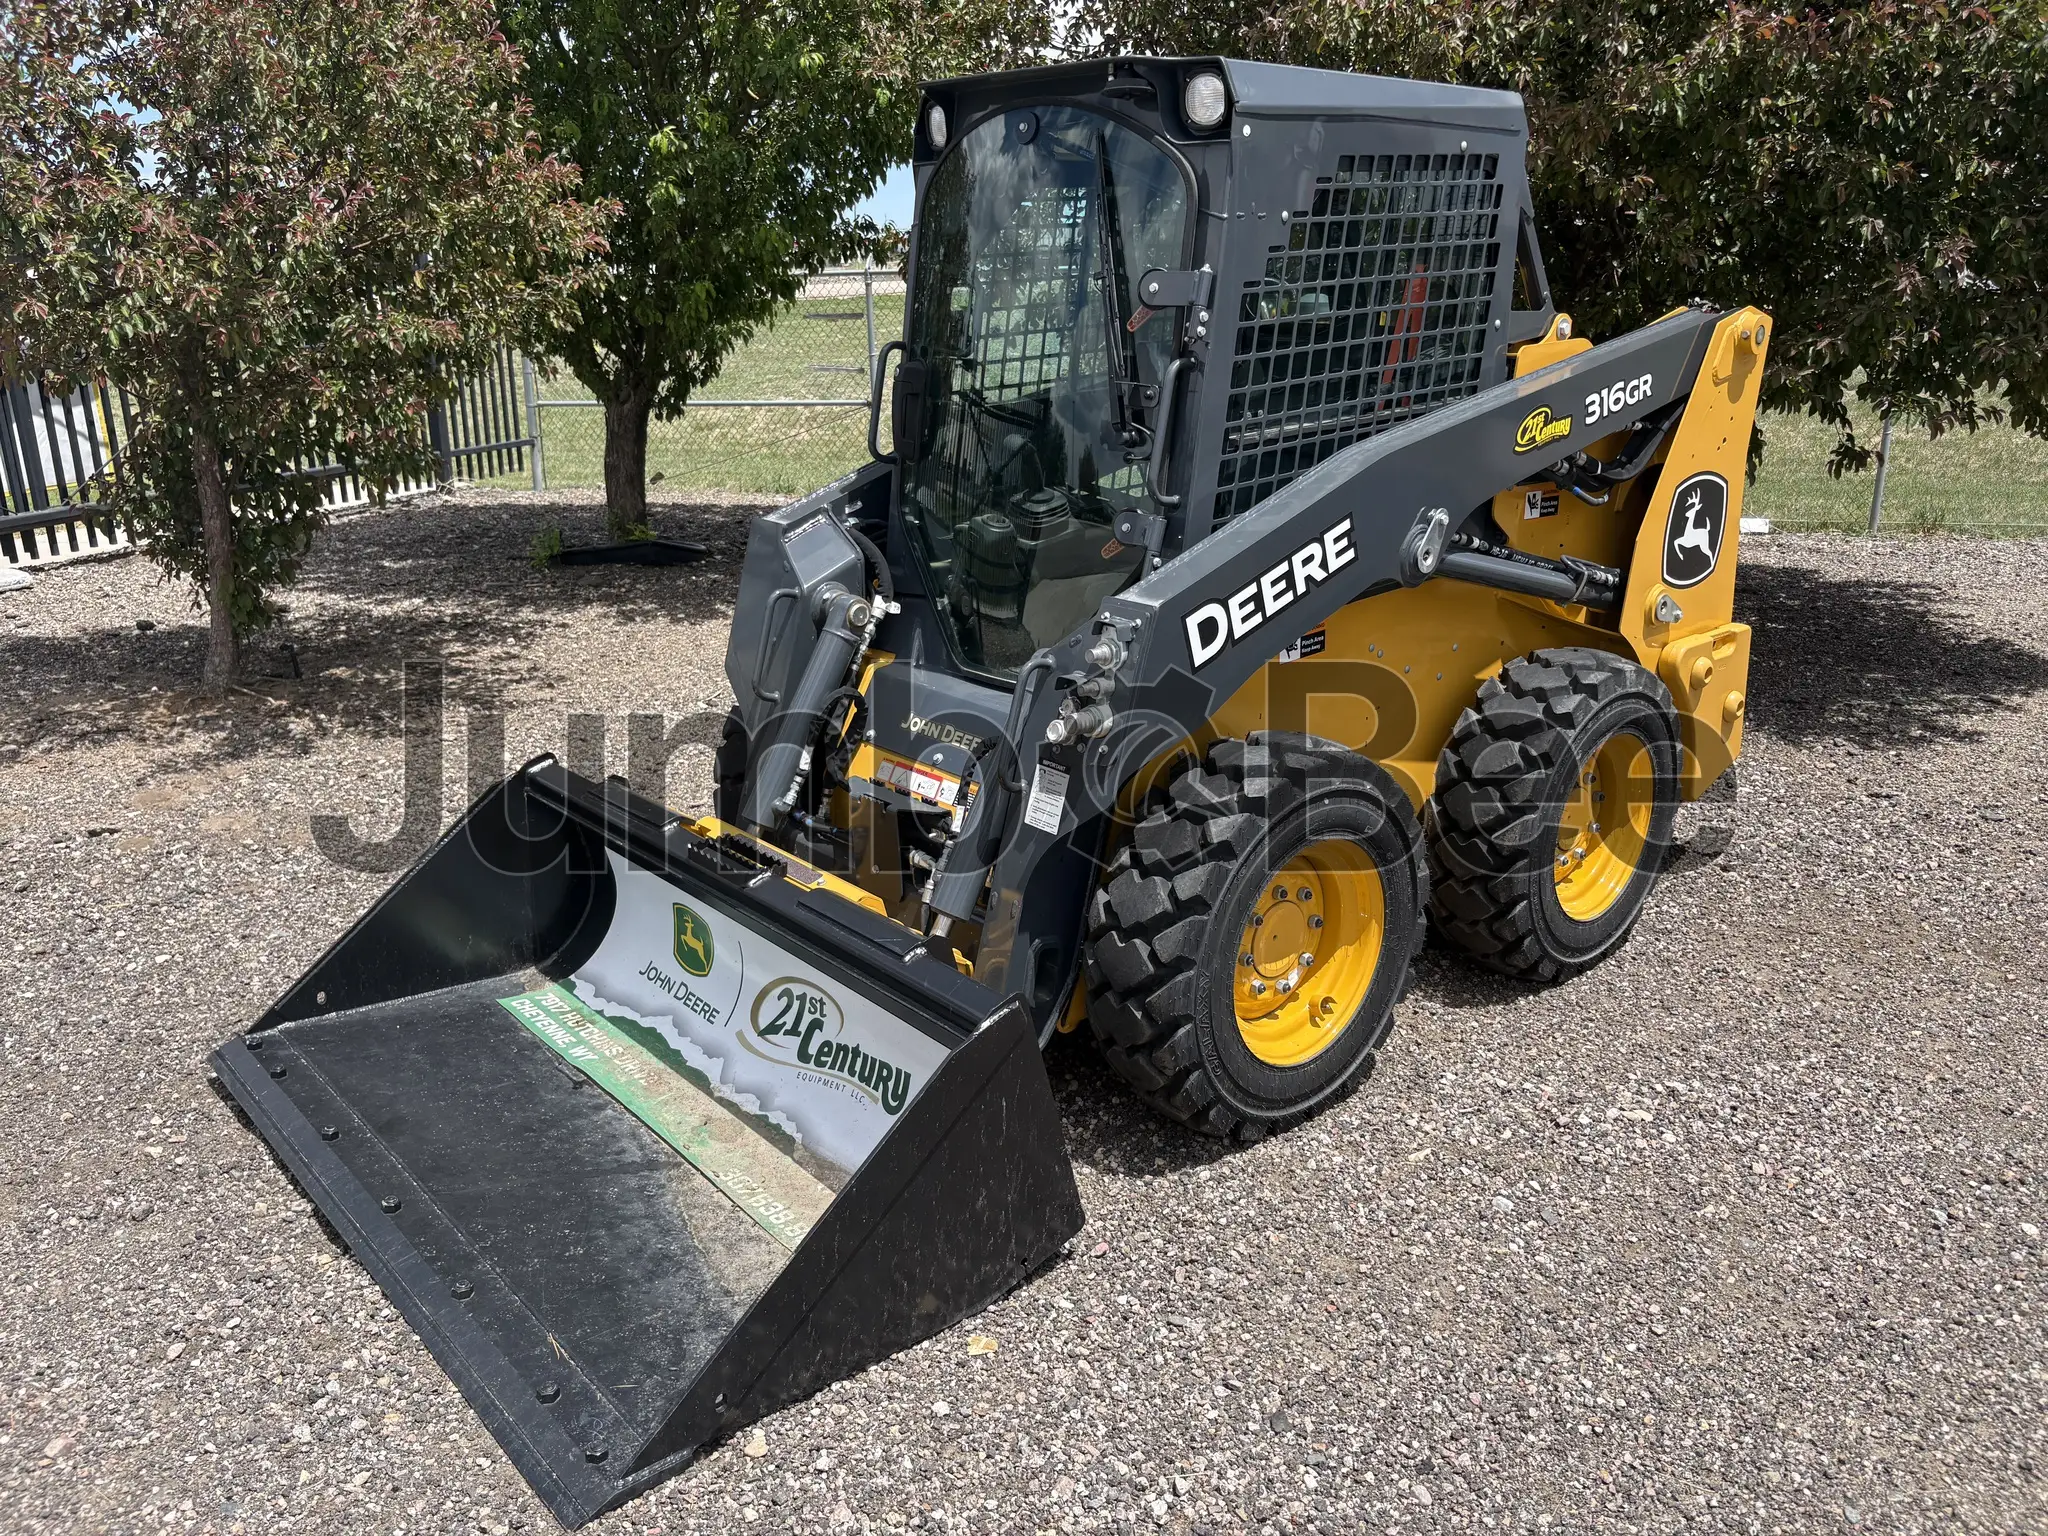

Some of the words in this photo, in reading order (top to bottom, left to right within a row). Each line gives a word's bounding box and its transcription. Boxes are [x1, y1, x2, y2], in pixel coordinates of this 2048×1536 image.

[1585, 373, 1653, 425] 316GR
[1185, 518, 1356, 668] DEERE
[901, 712, 941, 739] JOHN
[1042, 759, 1067, 772] IMPORTANT
[535, 993, 572, 1013] 7917
[638, 960, 677, 994] JOHN
[673, 981, 721, 1025] DEERE
[757, 987, 827, 1037] 21st
[510, 999, 577, 1048] CHEYENNE,
[568, 1045, 600, 1061] WY
[796, 1071, 847, 1093] EQUIPMENT
